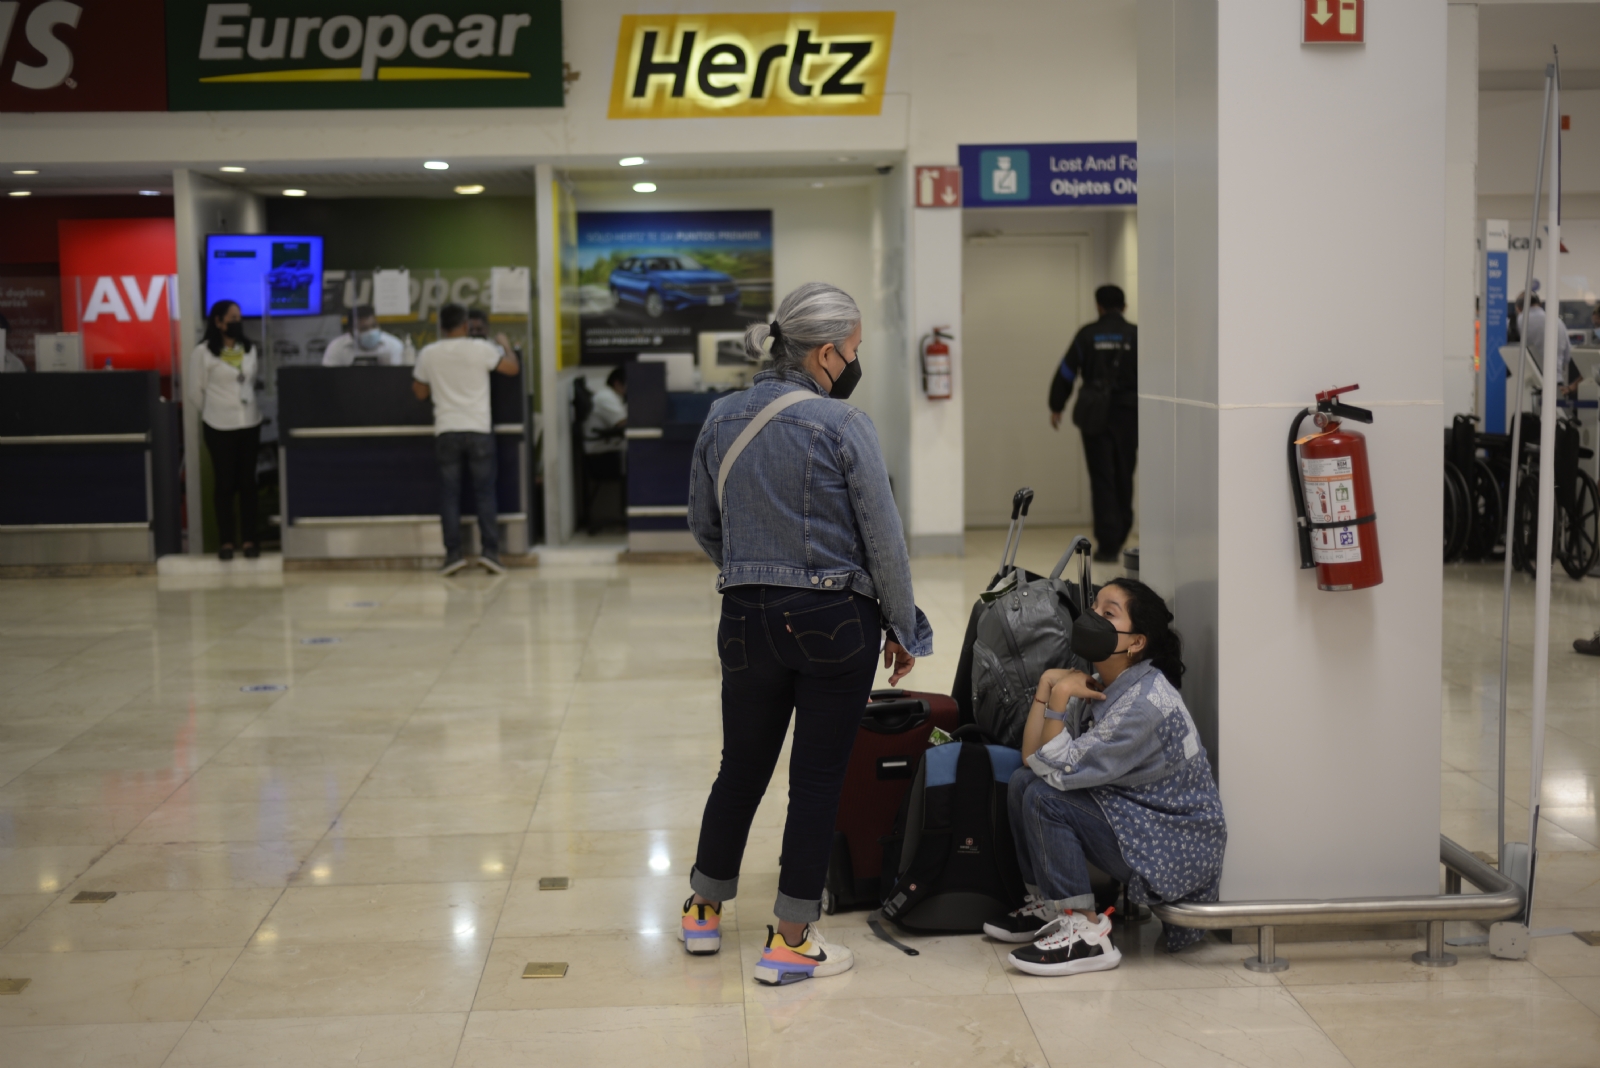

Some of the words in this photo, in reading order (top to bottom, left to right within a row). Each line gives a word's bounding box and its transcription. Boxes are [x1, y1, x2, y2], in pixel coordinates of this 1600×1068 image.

[199, 3, 530, 81] Europcar
[632, 29, 874, 98] Hertz
[1050, 156, 1083, 172] Lost
[1084, 155, 1116, 171] And
[1119, 154, 1137, 171] Fo
[1050, 179, 1111, 198] Objetos
[82, 274, 180, 322] AVI
